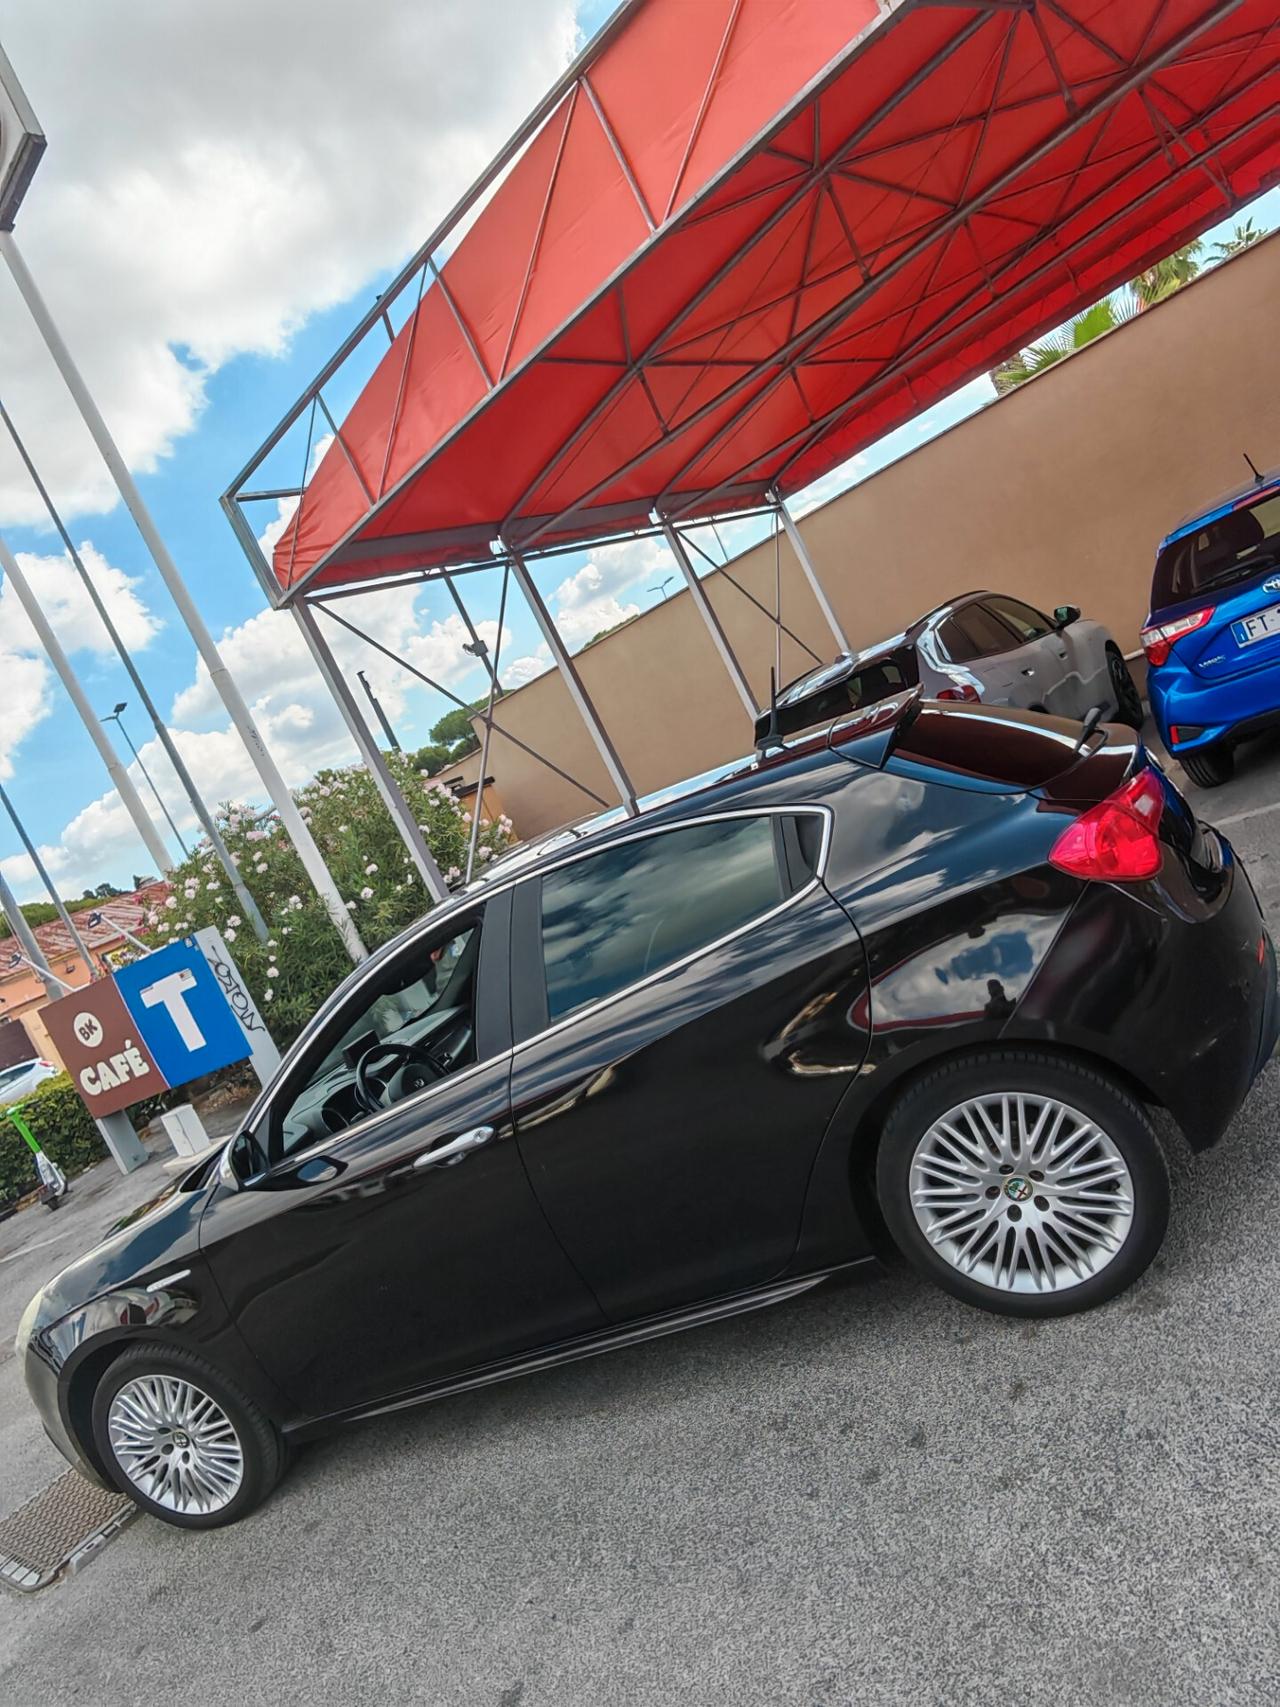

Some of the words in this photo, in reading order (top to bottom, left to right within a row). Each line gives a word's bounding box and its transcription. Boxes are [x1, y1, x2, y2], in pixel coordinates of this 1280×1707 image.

[78, 1018, 98, 1041] BK
[139, 967, 208, 1053] T
[80, 1039, 150, 1096] CAFÉ
